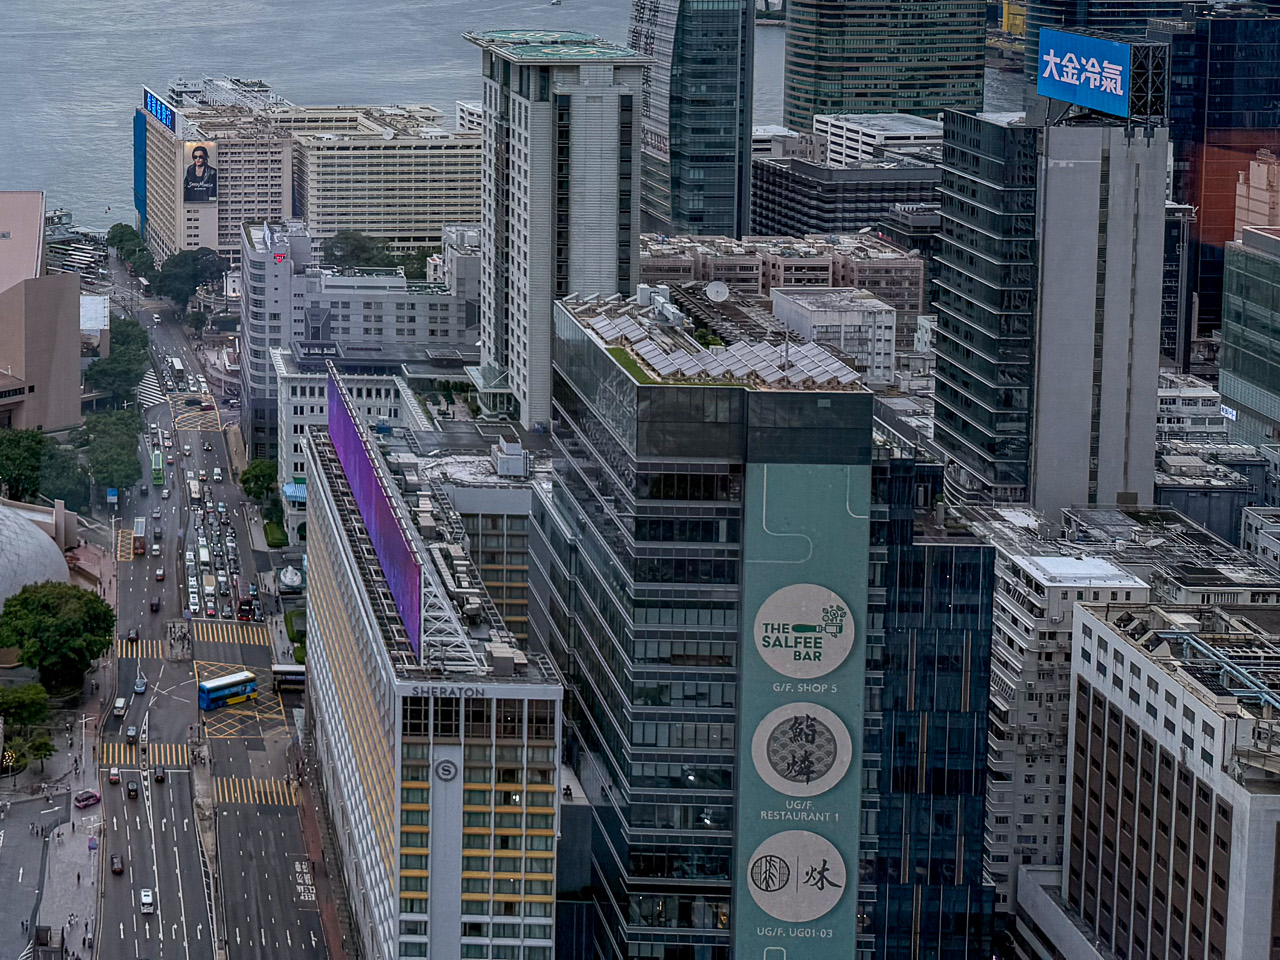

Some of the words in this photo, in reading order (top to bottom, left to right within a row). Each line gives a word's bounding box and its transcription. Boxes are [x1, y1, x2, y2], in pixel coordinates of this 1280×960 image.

[1042, 48, 1124, 96] 大金冷氣
[649, 130, 669, 154] UBS
[762, 623, 790, 634] THE
[762, 635, 823, 649] SALFEE
[793, 651, 822, 662] BAR
[412, 686, 485, 698] SHERATON
[797, 683, 828, 693] SHOP
[831, 685, 837, 693] 5
[760, 810, 831, 821] RESTAURANT
[300, 892, 315, 901] KEEP
[789, 928, 833, 937] UG01-03
